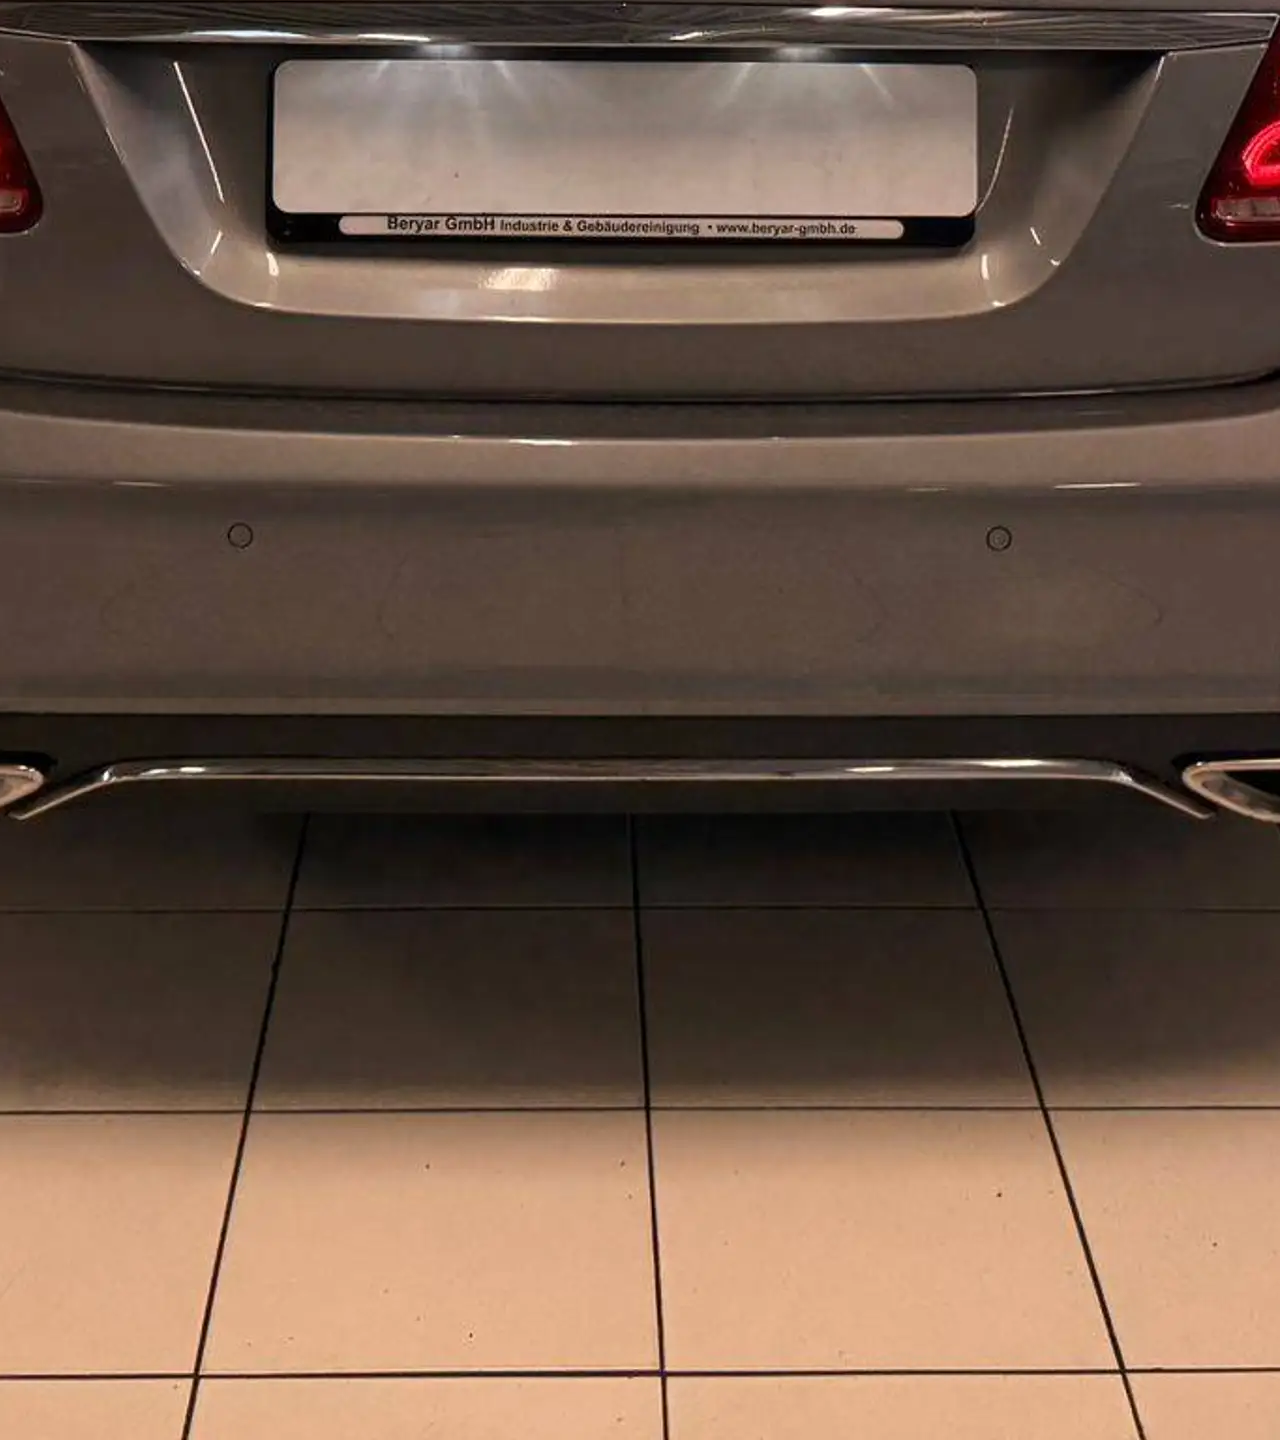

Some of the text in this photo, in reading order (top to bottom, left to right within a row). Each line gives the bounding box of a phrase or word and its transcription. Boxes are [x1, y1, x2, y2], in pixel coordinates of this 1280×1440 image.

[387, 216, 856, 237] Beryar GmbH Industrie & Gebäudereinigung www.beryar-gmbh.de
